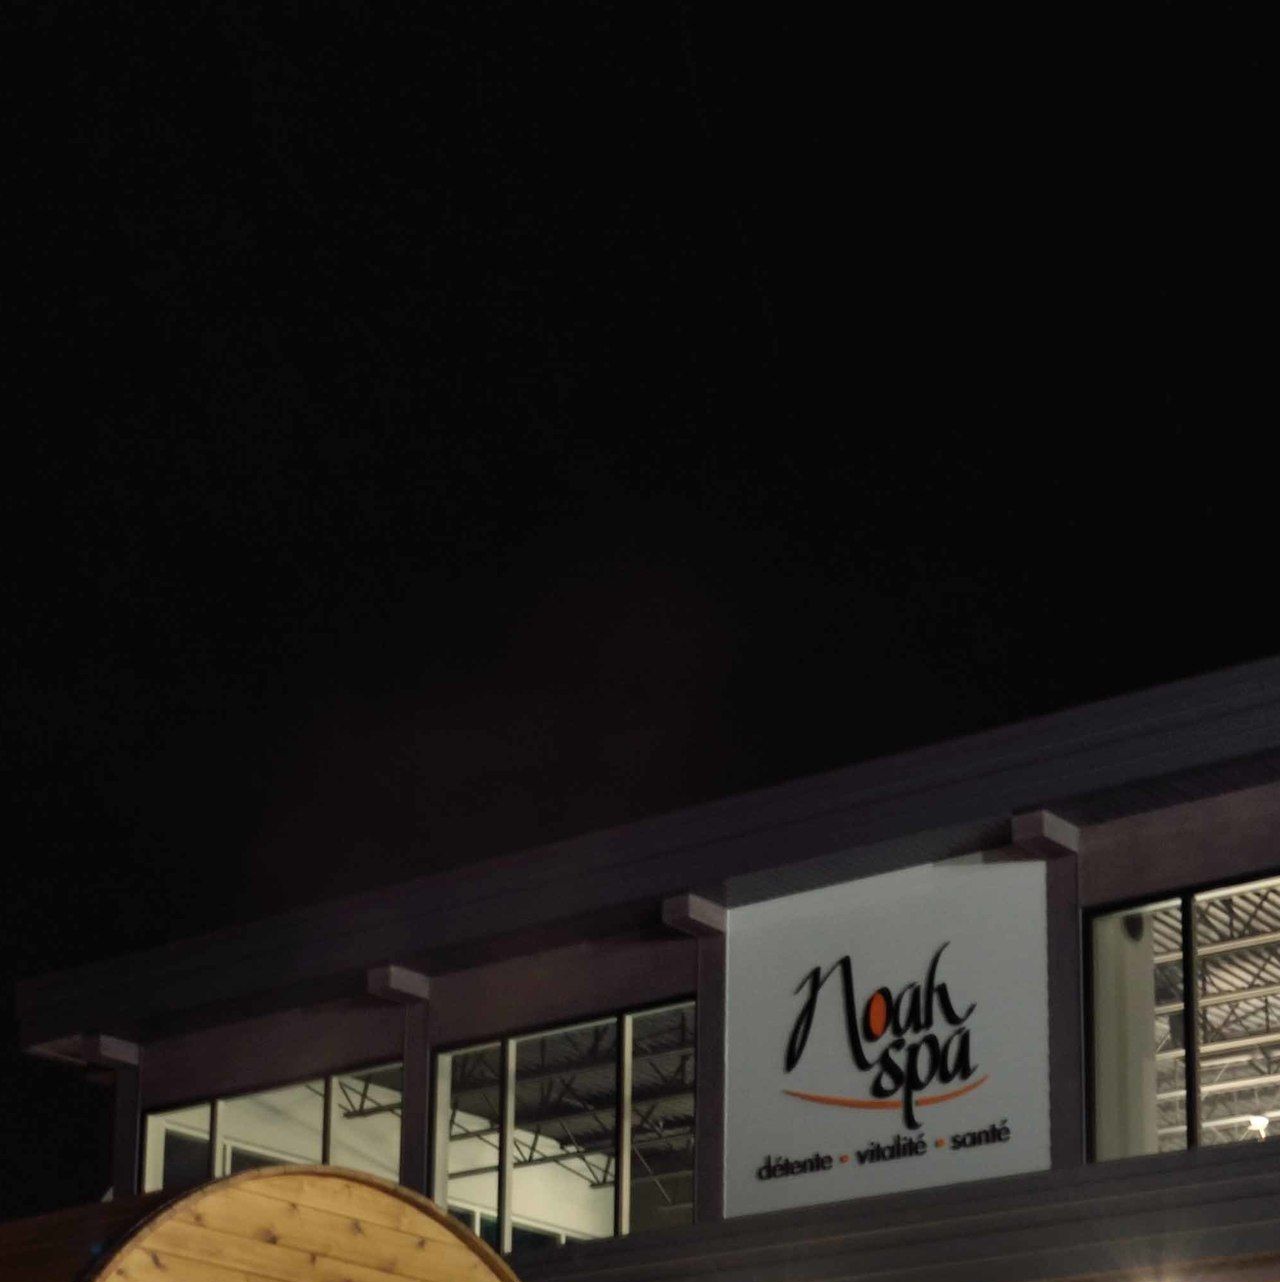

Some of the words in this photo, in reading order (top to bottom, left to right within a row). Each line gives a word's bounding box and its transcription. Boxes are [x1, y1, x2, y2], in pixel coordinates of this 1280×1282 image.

[784, 940, 977, 1074] Noah
[870, 1026, 979, 1130] spa
[756, 1153, 834, 1182] détente
[855, 1131, 928, 1166] vitalité
[949, 1118, 1011, 1150] santé
